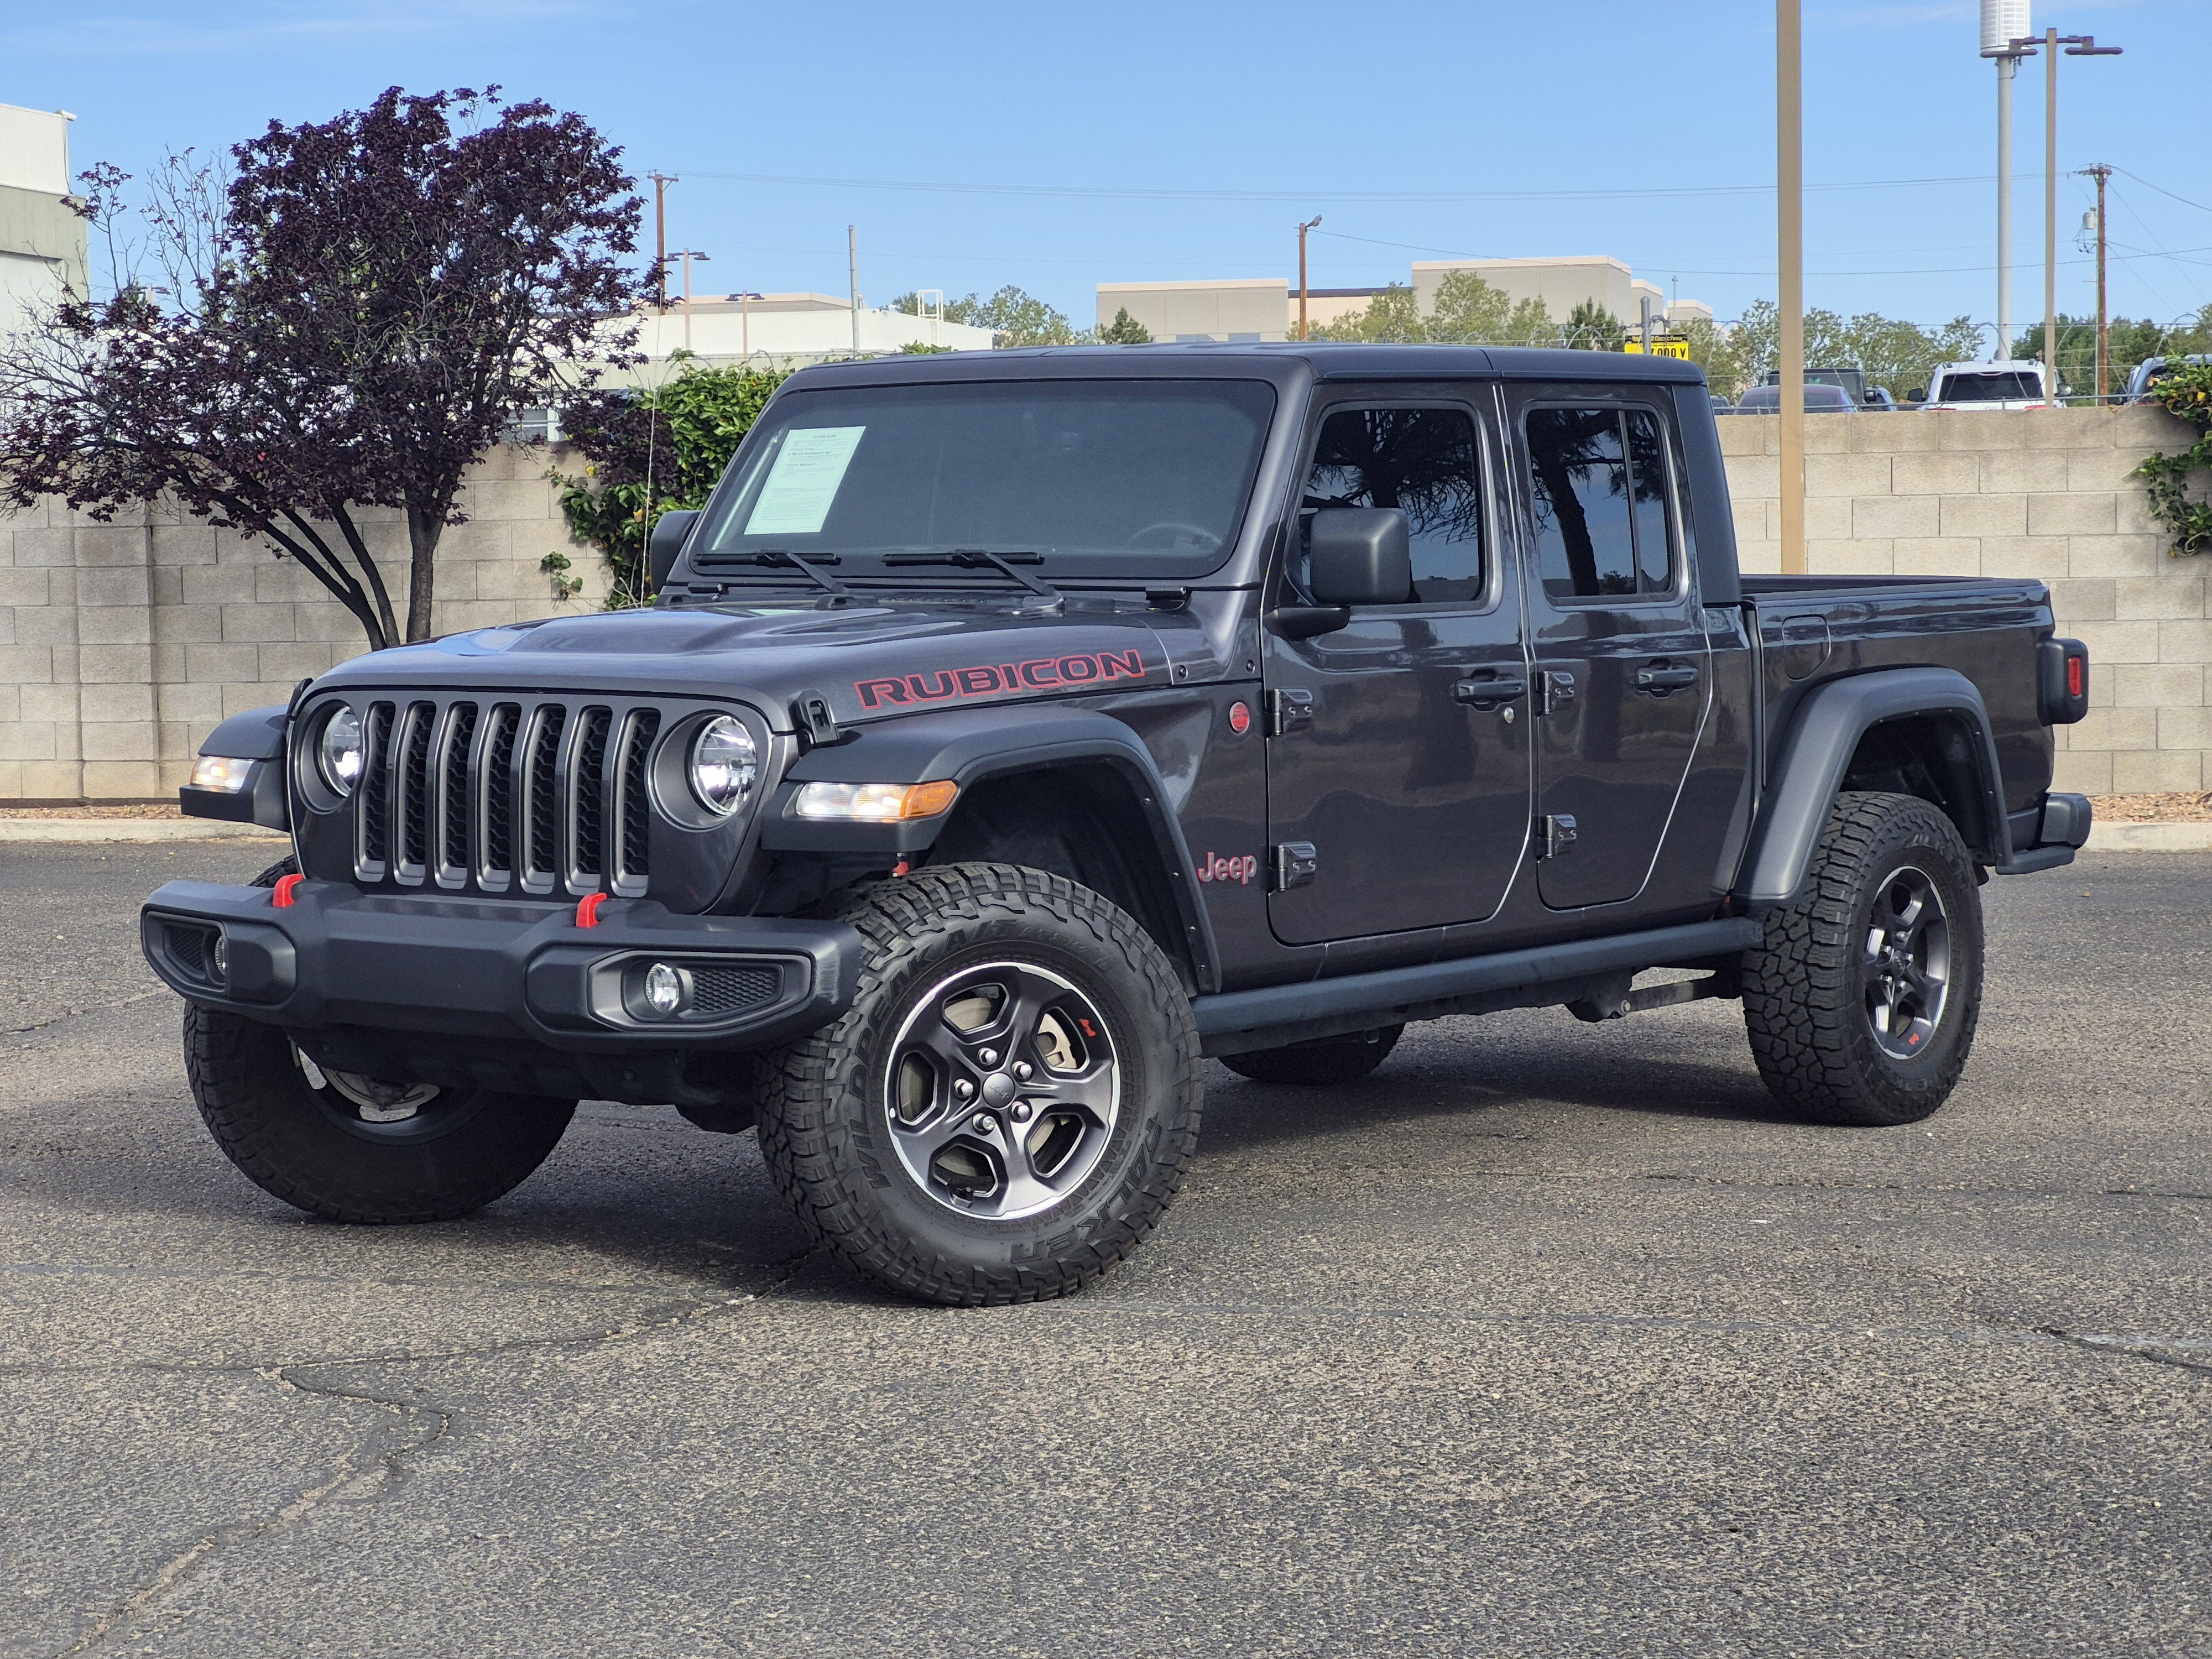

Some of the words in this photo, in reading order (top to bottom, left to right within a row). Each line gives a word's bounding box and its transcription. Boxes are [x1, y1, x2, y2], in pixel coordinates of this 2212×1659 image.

[1680, 348, 1687, 358] V
[854, 649, 1145, 710] RUBICON
[1198, 851, 1257, 885] Jeep
[850, 943, 935, 1189] WILDPEAK
[989, 1082, 1009, 1099] Jeep
[1010, 1112, 1162, 1263] FALKEN
